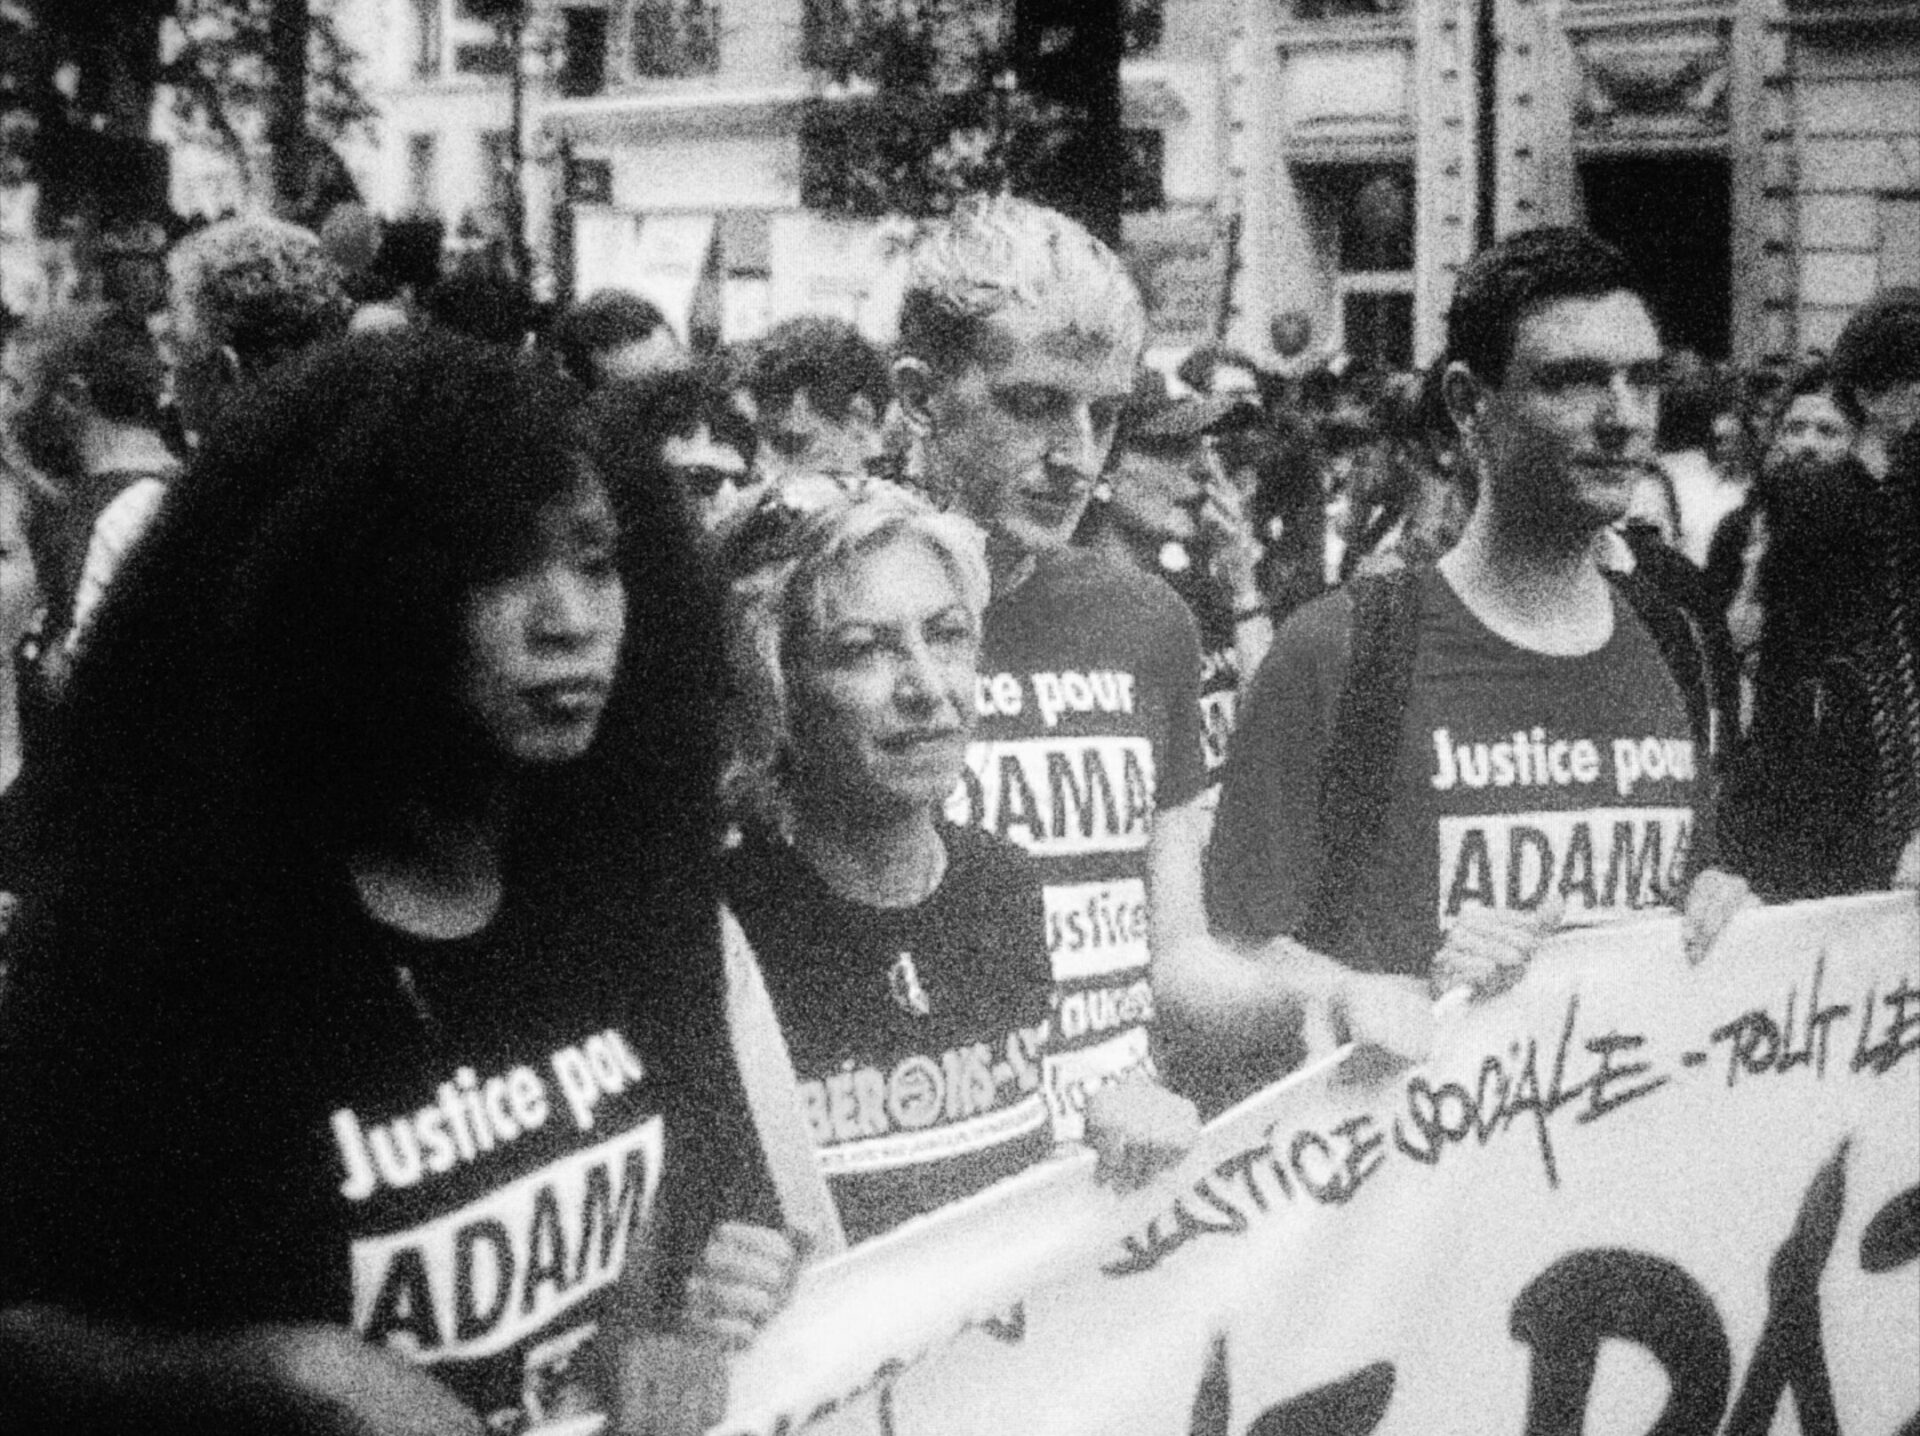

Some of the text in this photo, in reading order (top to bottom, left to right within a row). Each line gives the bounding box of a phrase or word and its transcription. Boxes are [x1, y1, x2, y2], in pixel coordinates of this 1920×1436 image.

[1031, 669, 1137, 728] pour
[1430, 725, 1601, 790] Justice
[330, 1065, 549, 1201] Justice
